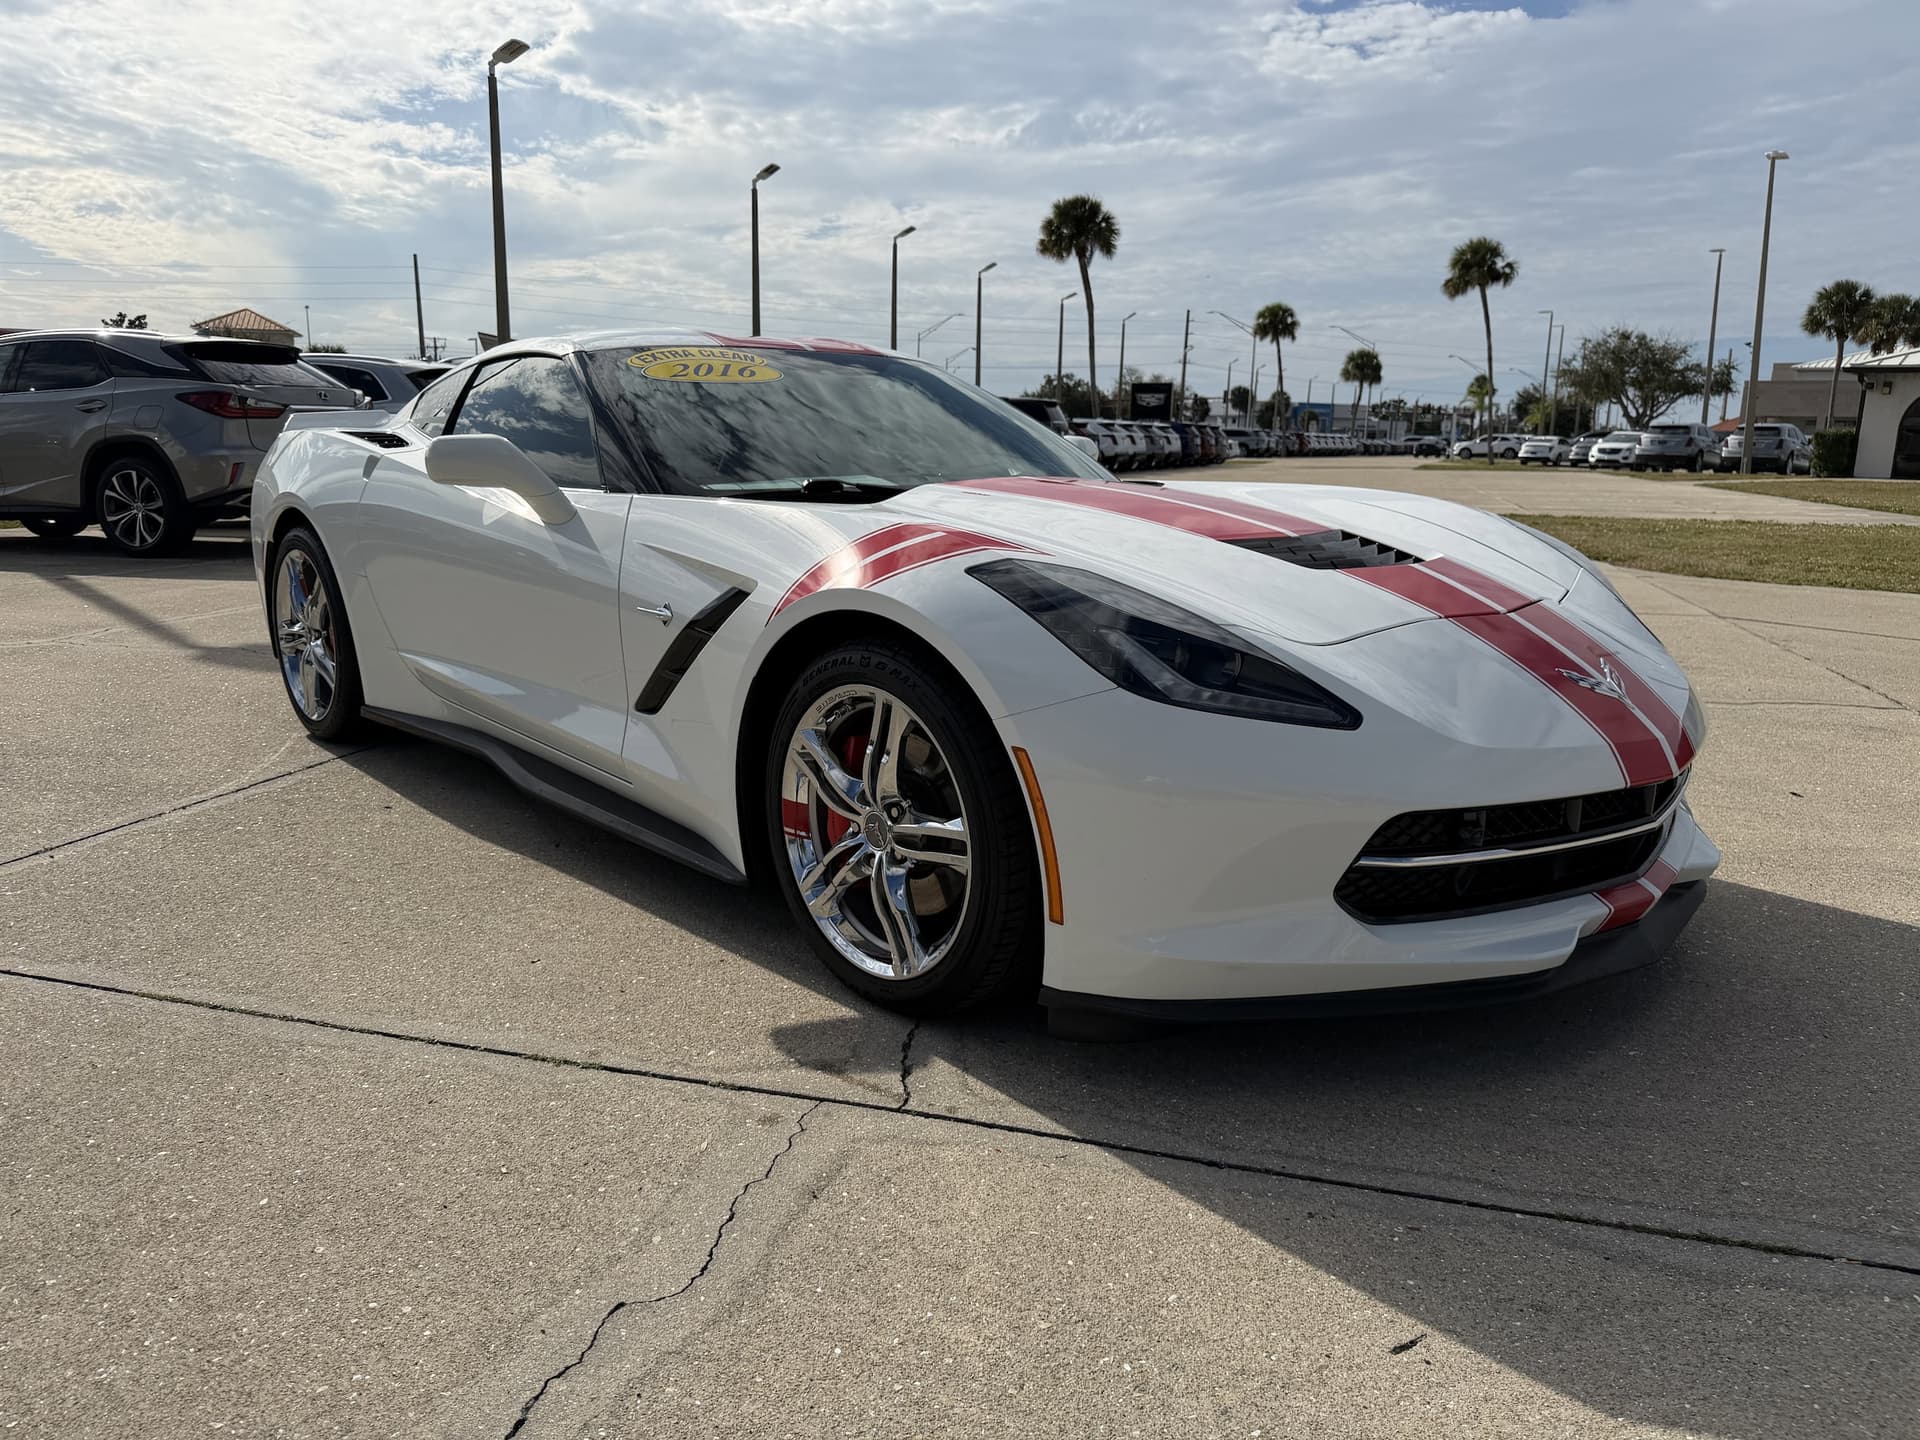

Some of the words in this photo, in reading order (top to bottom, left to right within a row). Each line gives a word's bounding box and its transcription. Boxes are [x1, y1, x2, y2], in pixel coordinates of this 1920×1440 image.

[634, 349, 695, 364] EXTRA
[698, 349, 756, 363] CLEAN
[669, 363, 757, 378] 2016
[801, 655, 855, 688] GENERAL
